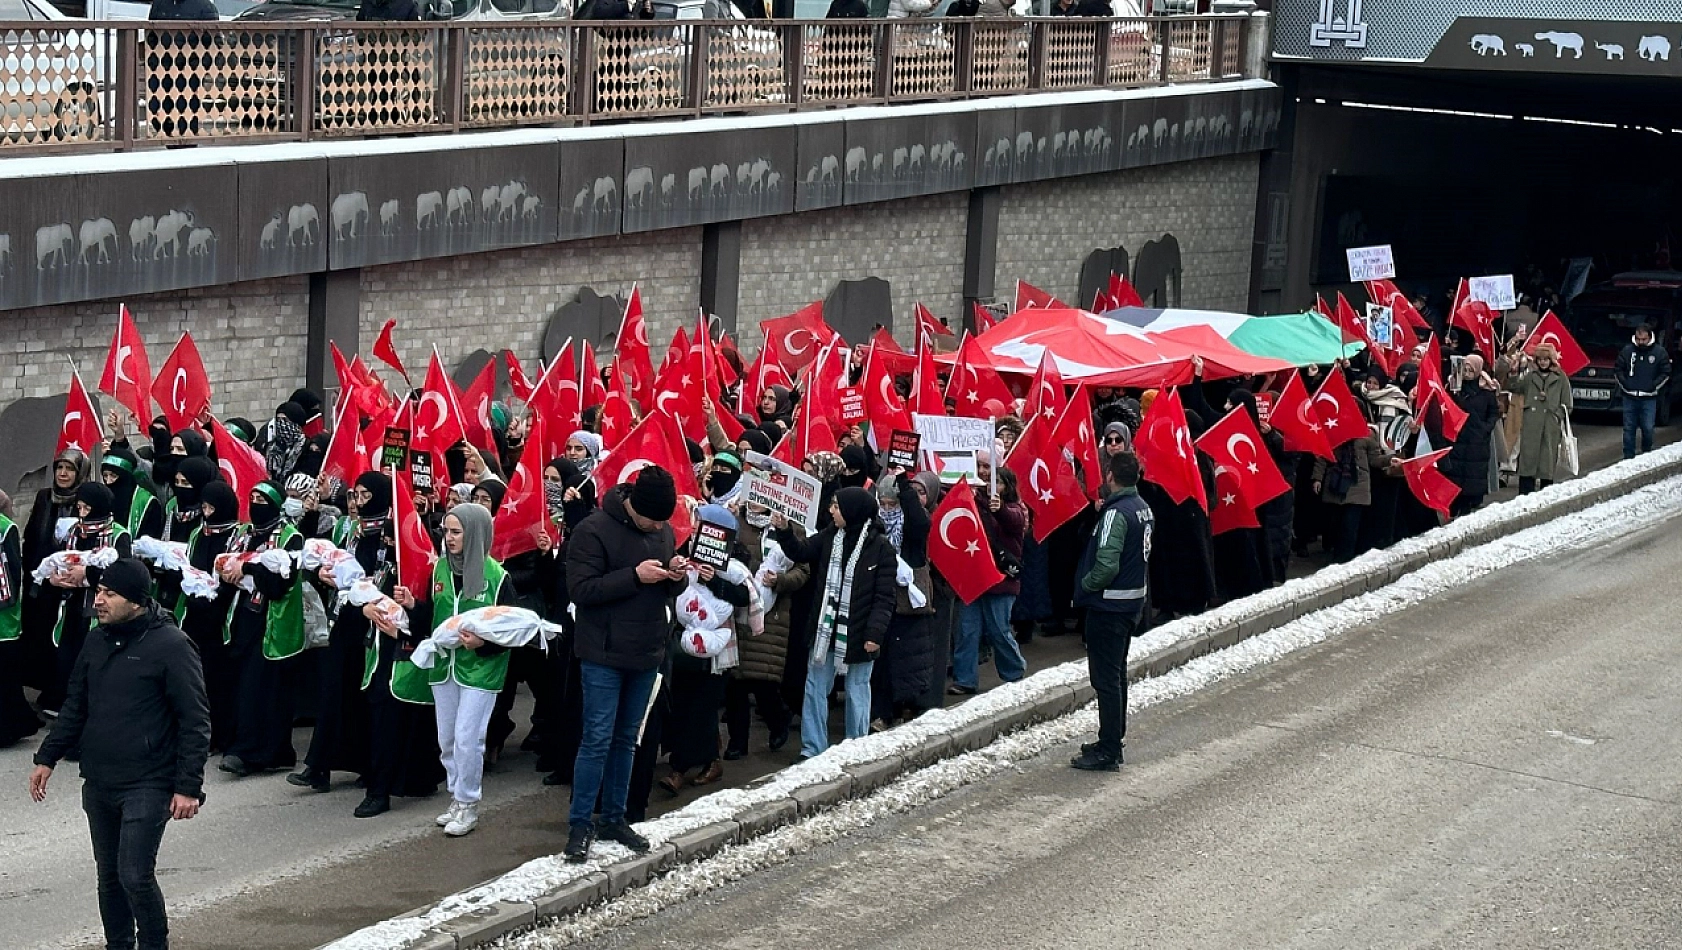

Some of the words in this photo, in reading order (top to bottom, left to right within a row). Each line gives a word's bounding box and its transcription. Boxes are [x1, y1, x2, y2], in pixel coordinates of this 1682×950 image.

[784, 494, 809, 513] DESTEK
[788, 507, 807, 524] LANET
[698, 534, 727, 550] RESIST
[697, 544, 729, 561] RETURN
